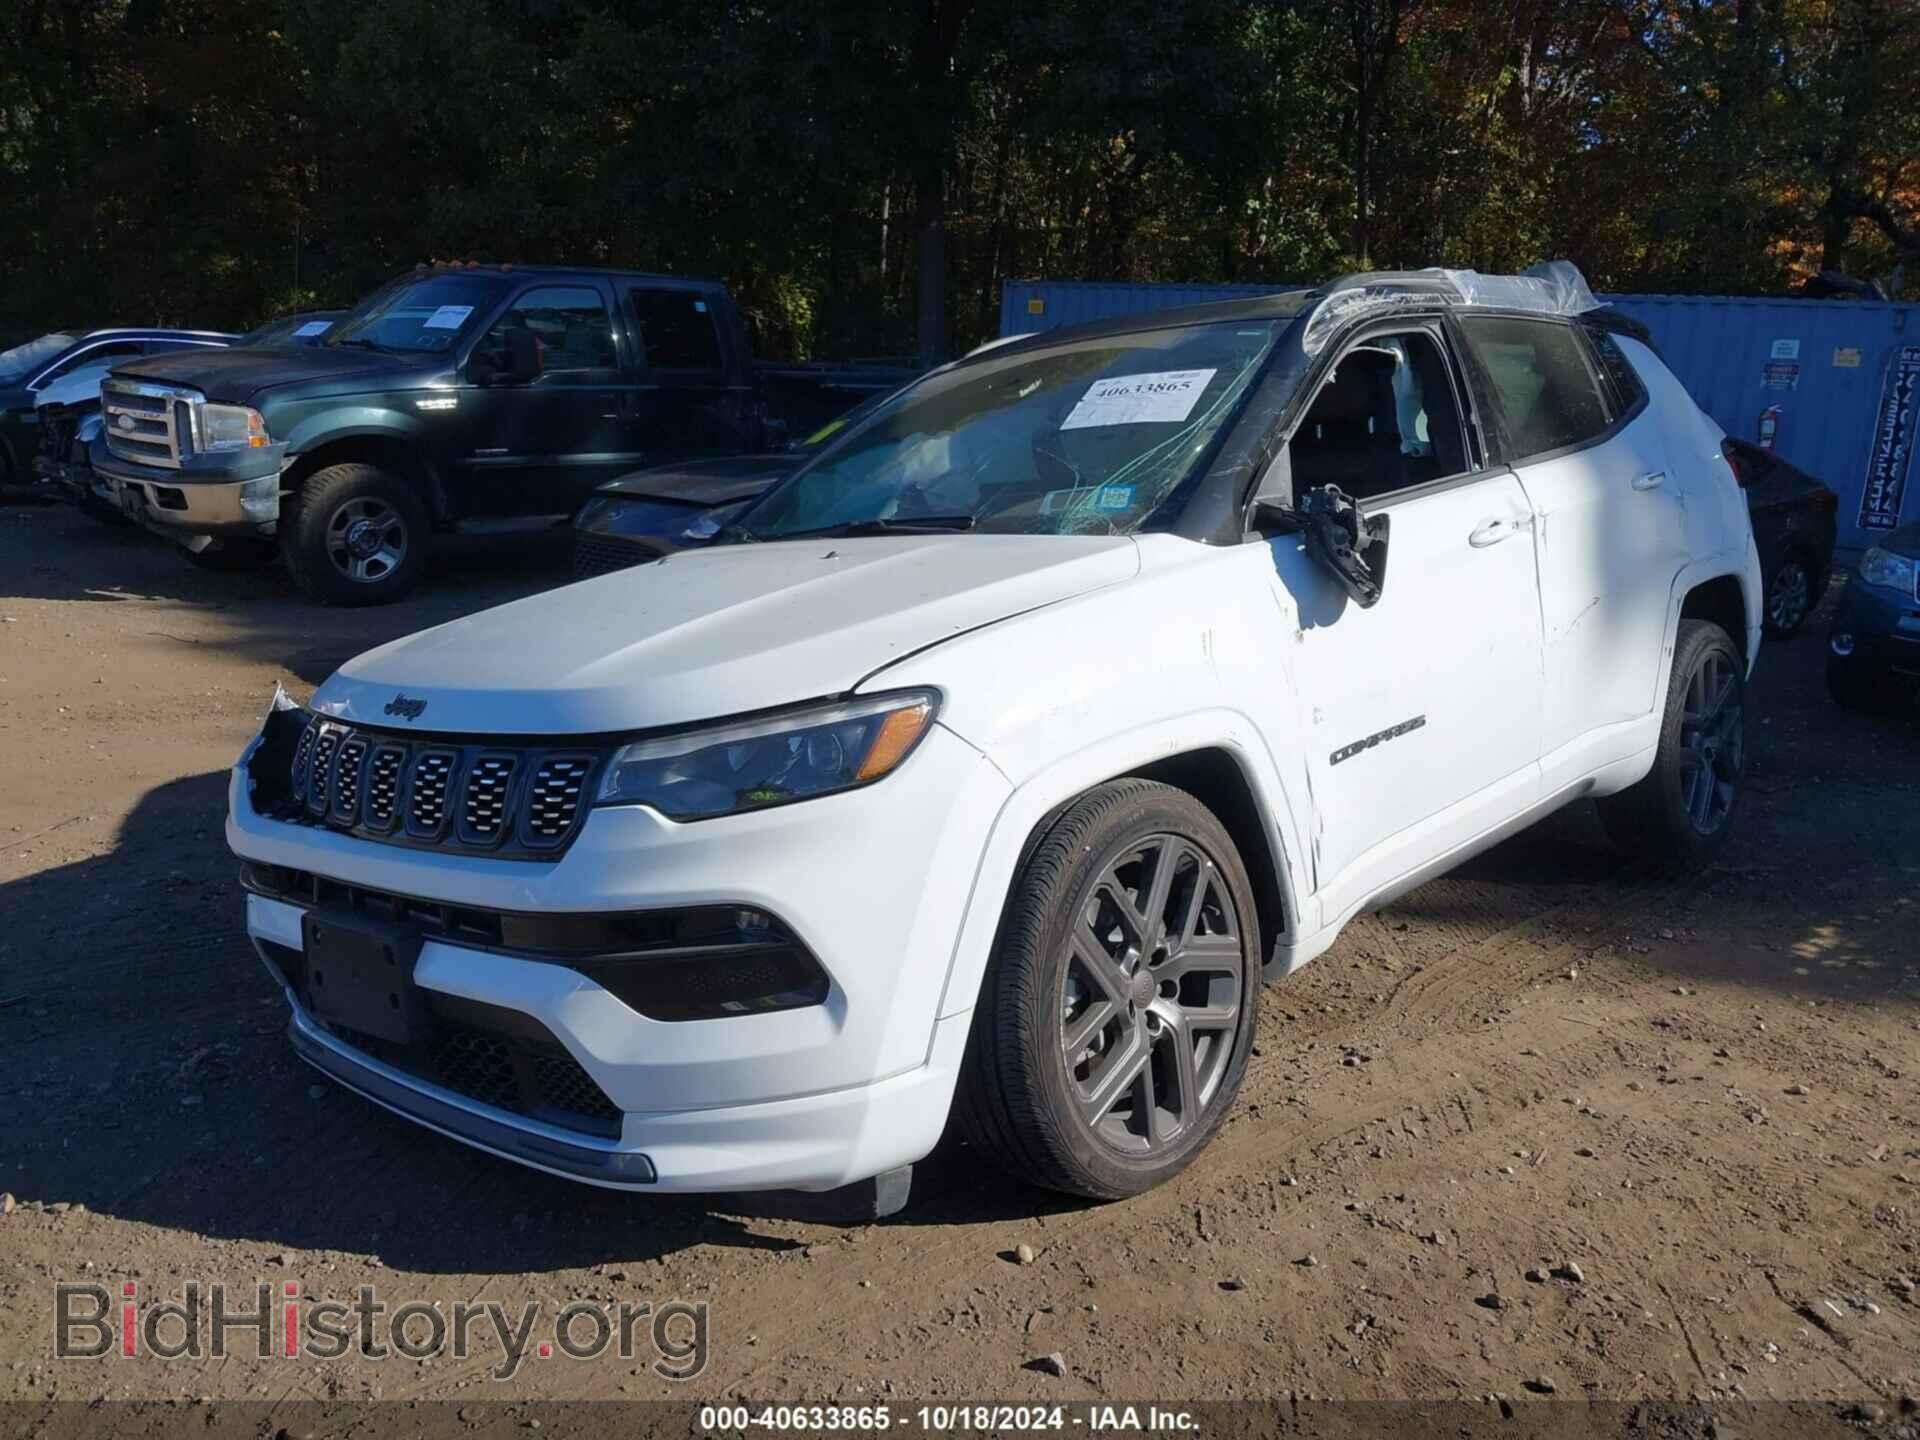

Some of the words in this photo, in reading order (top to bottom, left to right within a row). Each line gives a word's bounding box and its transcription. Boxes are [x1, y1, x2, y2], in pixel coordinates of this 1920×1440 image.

[1096, 381, 1193, 397] 40633865
[383, 693, 428, 721] Jeep
[1329, 714, 1426, 766] COMPASS
